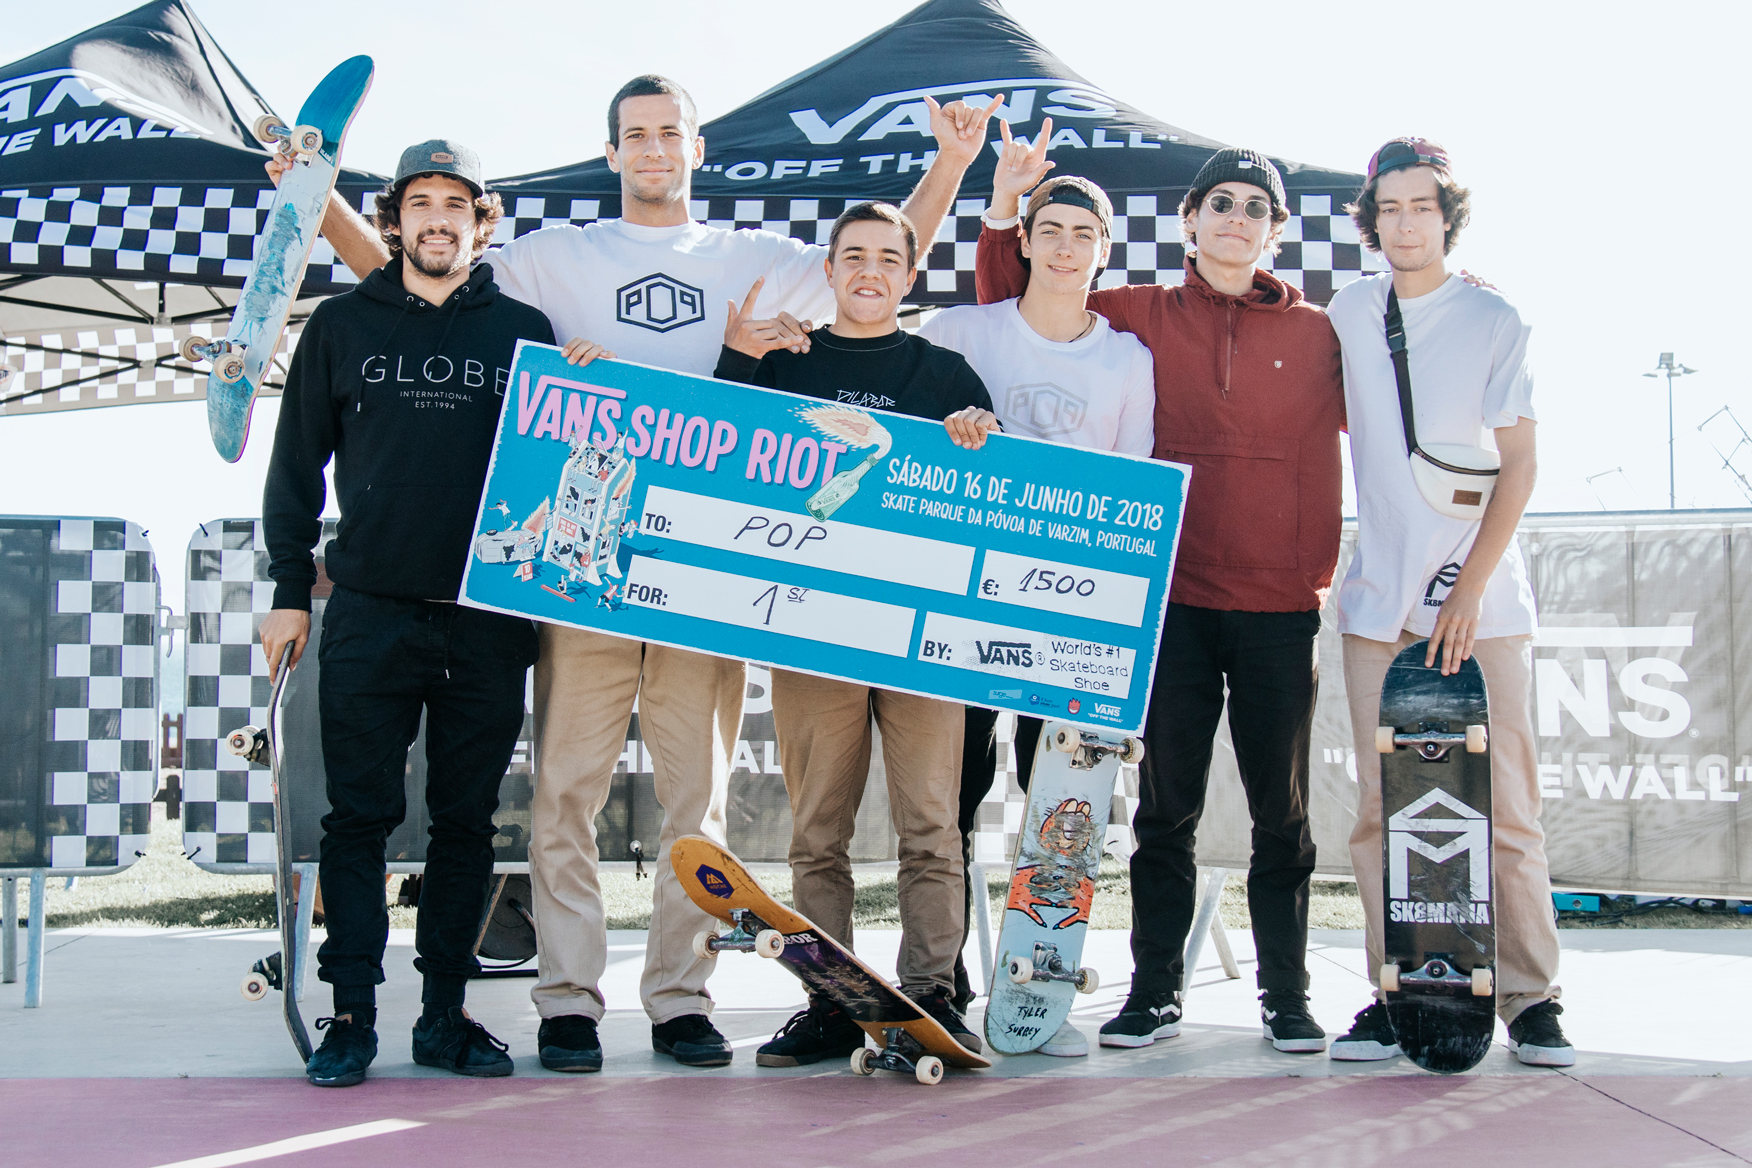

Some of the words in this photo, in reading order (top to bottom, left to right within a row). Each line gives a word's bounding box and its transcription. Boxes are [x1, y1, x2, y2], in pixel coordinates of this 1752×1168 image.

[859, 149, 938, 174] TH
[362, 355, 510, 397] GLOBE
[400, 391, 473, 402] INTERNATIONAL
[415, 401, 455, 410] EST.1994
[517, 370, 628, 452] VANS
[629, 405, 738, 472] SHOP
[745, 428, 848, 490] RIOT
[886, 454, 957, 495] SÁBADO
[963, 472, 983, 499] 16
[987, 476, 1012, 504] DE
[1015, 482, 1083, 518] JUNHO
[1087, 494, 1112, 522] DE
[1114, 500, 1164, 531] 2018
[645, 513, 672, 534] TO:
[734, 516, 827, 551] POP
[881, 492, 918, 517] SKATE
[919, 498, 965, 523] PARQUE
[968, 504, 984, 525] DA
[985, 509, 1025, 533] PÓVOA
[1028, 518, 1045, 537] DE
[1048, 522, 1092, 548] VARZIM,
[1096, 531, 1157, 557] PORTUGAL
[1018, 567, 1096, 597] 1500
[626, 583, 668, 606] FOR:
[1423, 598, 1445, 608] SK8M
[923, 640, 952, 661] BY:
[976, 640, 1034, 668] VANS
[1051, 641, 1102, 658] World's
[1105, 644, 1121, 659] #1
[1050, 658, 1129, 678] Skateboard
[1074, 676, 1110, 691] Shoe
[1094, 702, 1122, 717] VANS
[1017, 1005, 1047, 1020] TYLER
